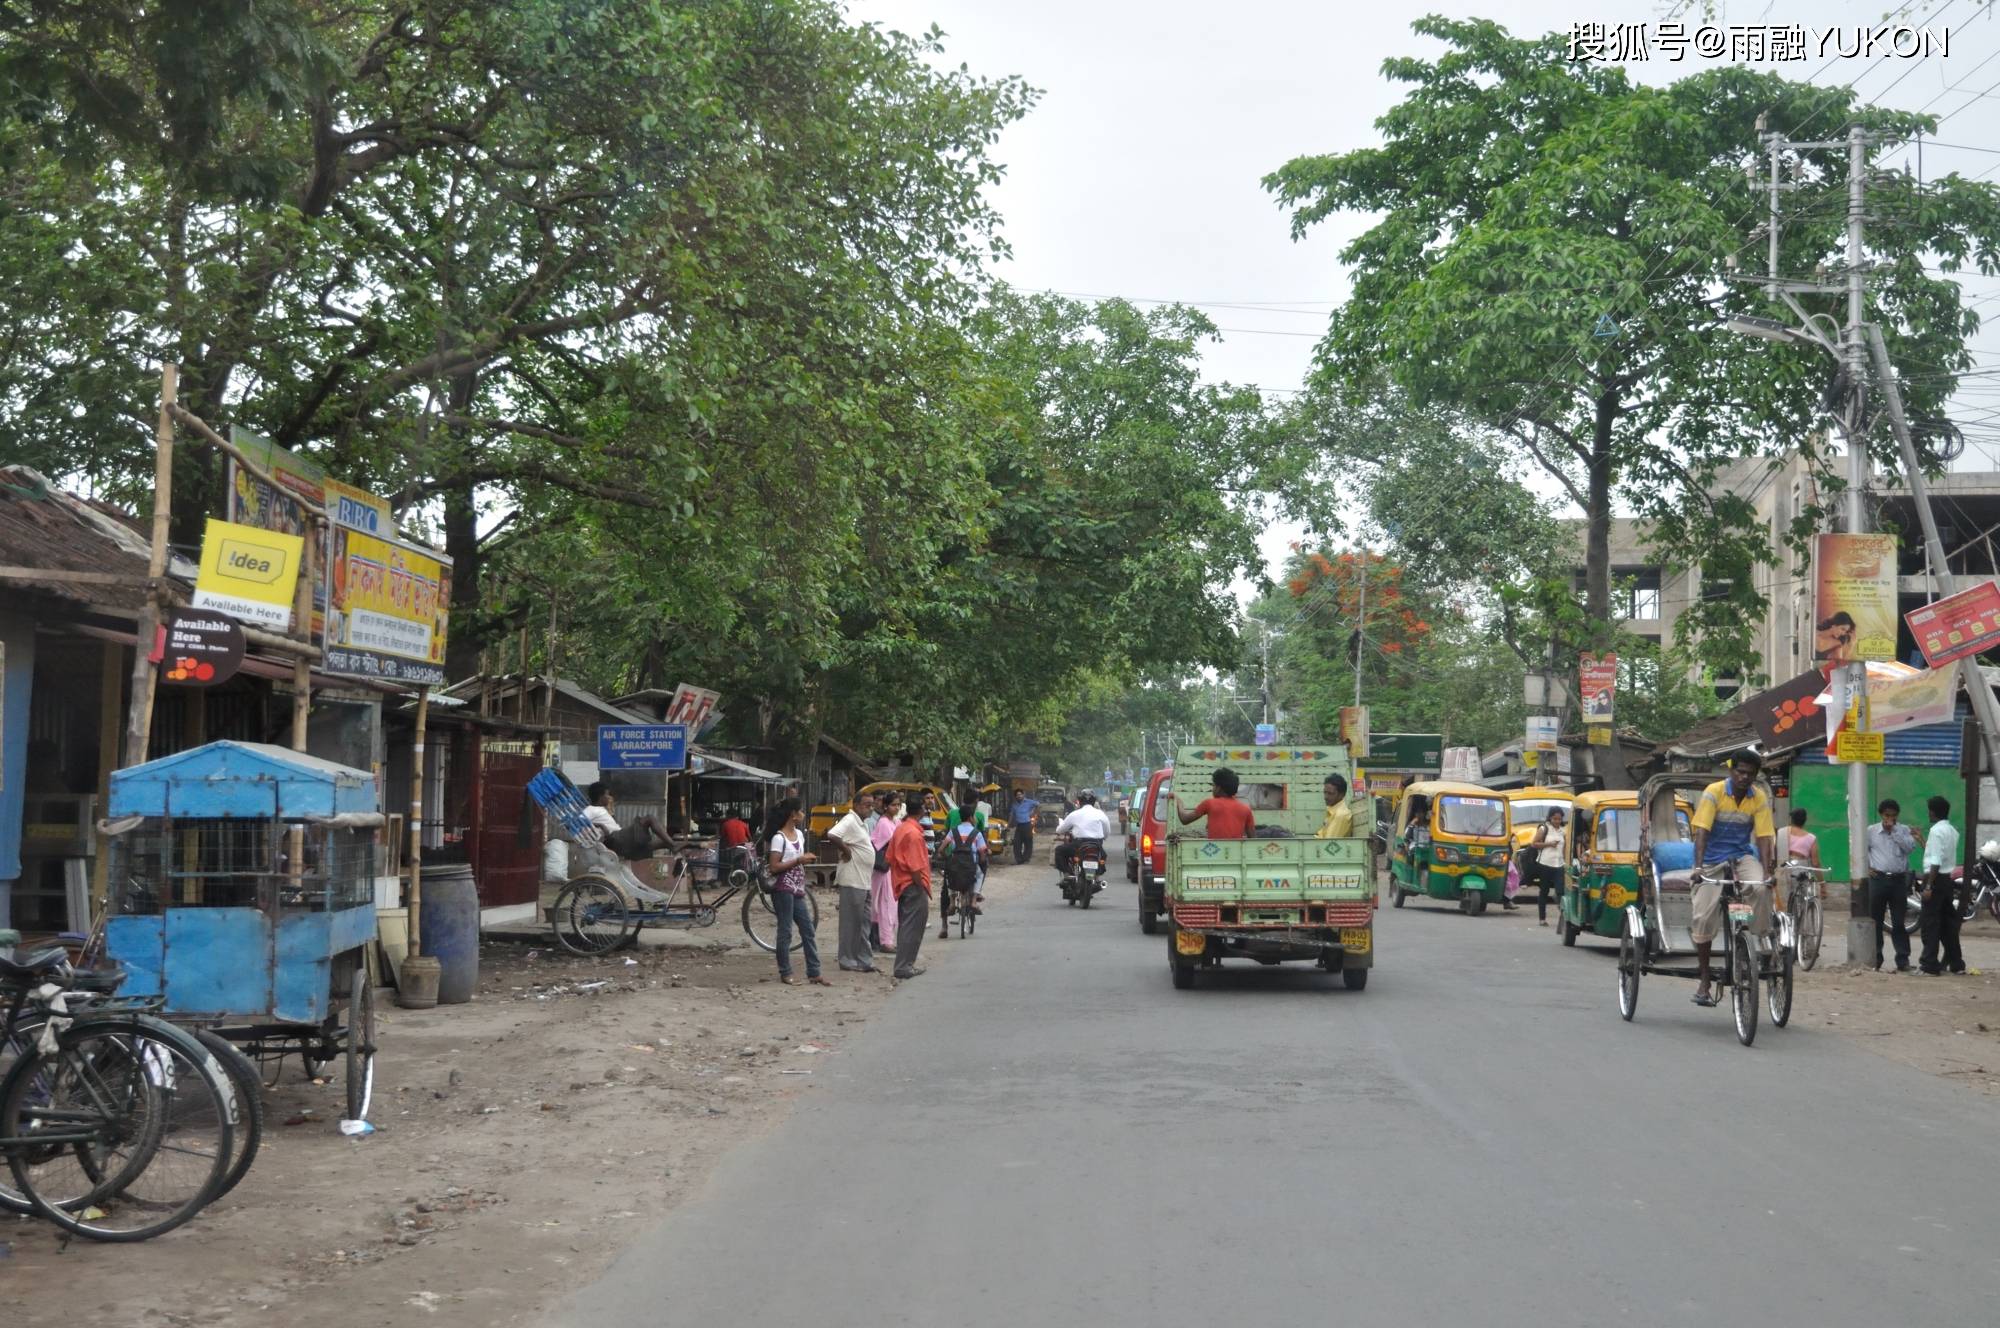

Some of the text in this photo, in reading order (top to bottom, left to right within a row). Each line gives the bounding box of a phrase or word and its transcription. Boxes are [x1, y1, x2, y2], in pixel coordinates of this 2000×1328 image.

[340, 498, 378, 531] BBC
[202, 597, 283, 621] Available Here
[174, 618, 231, 632] Available
[172, 631, 202, 643] Here
[602, 730, 682, 740] AIR FORCE STATION
[611, 740, 673, 751] BARRACKPORE
[1256, 878, 1290, 889] TATA
